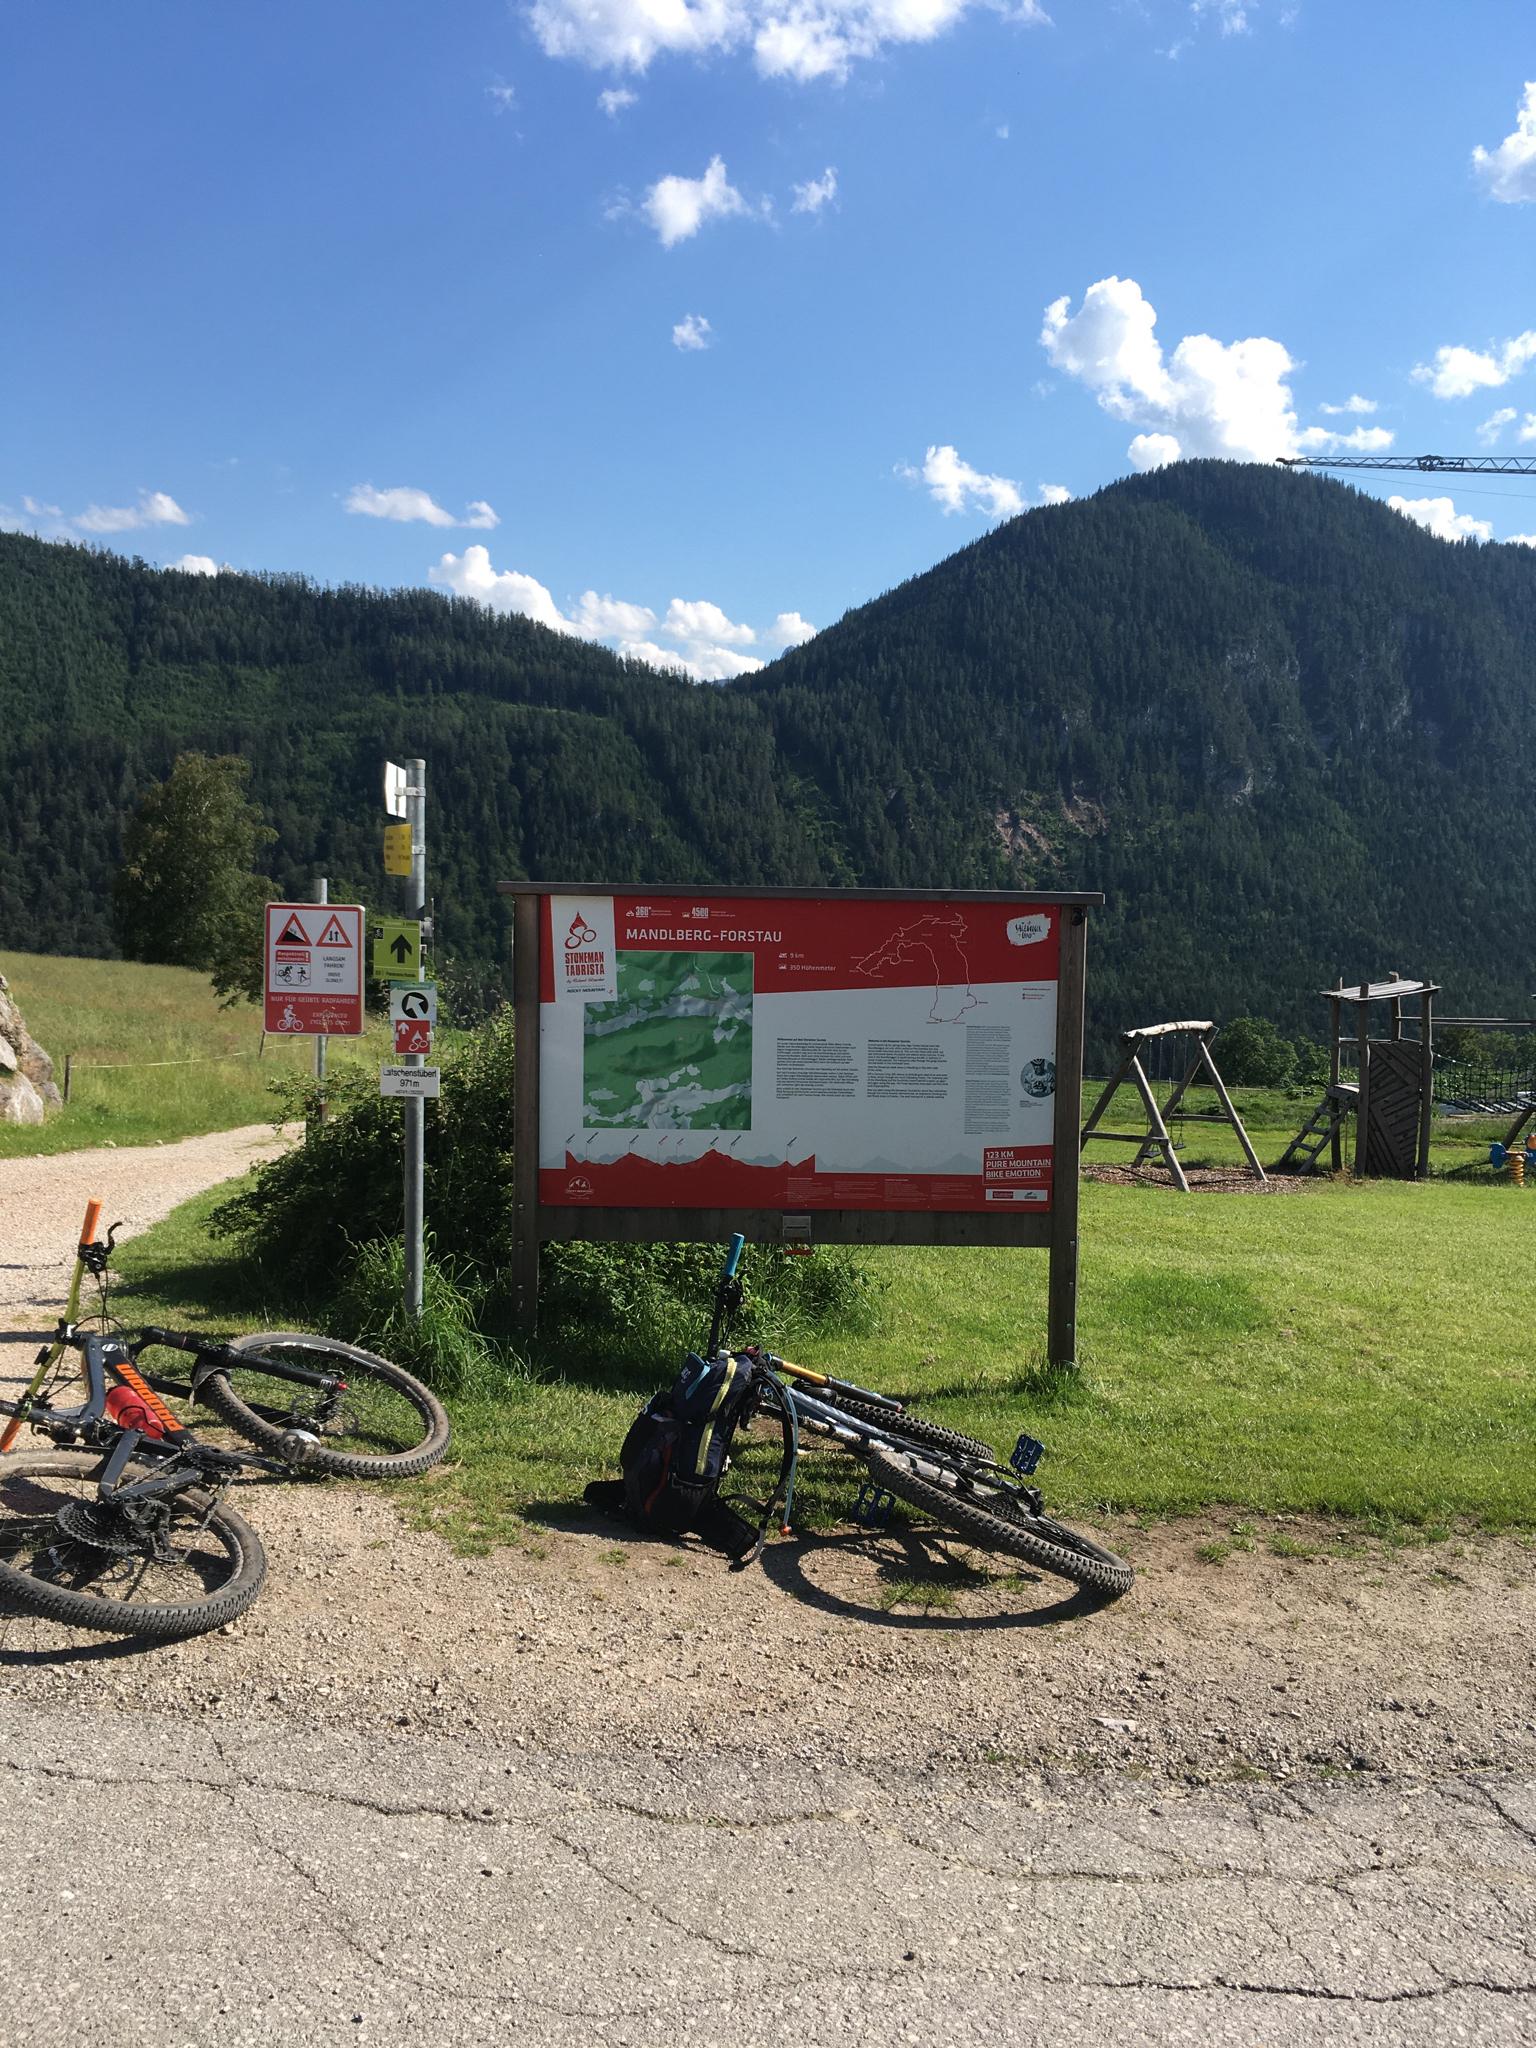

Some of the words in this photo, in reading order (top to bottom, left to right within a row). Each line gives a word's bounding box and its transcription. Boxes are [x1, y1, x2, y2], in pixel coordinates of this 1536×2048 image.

[691, 907, 709, 917] 4500
[626, 928, 782, 942] MANDLBERG-FORSTAU
[565, 951, 604, 964] STONEMAN
[565, 964, 605, 976] TAURISTA
[986, 1151, 999, 1159] 123
[1000, 1150, 1014, 1158] KM
[986, 1160, 1008, 1168] PURE
[1009, 1159, 1051, 1167] MOUNTAIN
[986, 1170, 1003, 1178] BIKE
